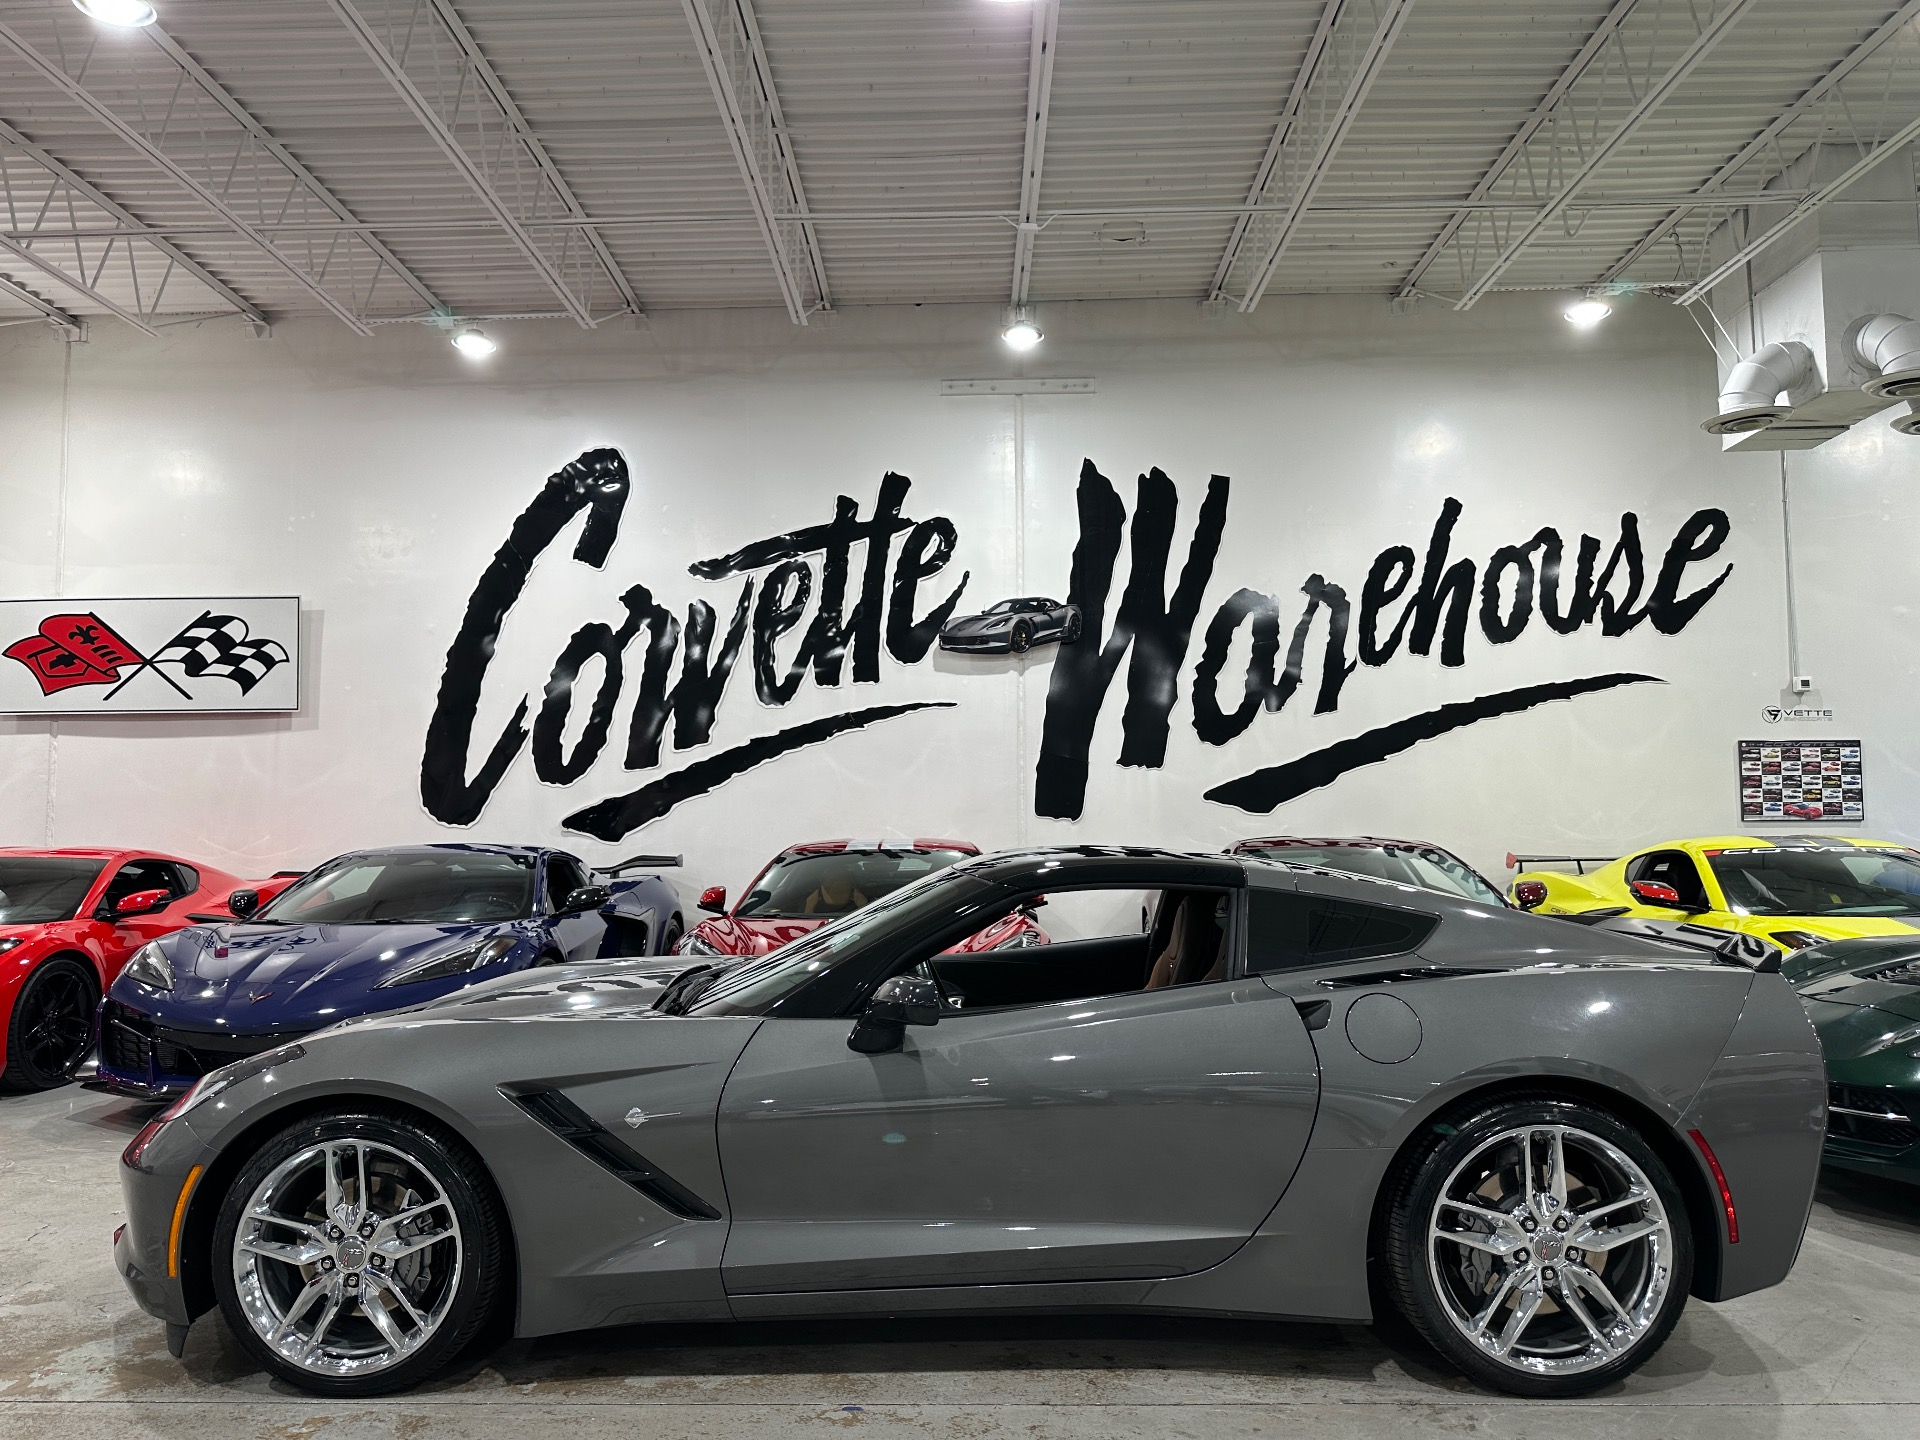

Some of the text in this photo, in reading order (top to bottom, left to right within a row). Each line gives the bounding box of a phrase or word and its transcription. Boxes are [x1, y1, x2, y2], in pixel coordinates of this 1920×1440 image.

[421, 447, 1733, 826] Corvette Warehouse
[1783, 709, 1833, 717] VETTE
[1722, 847, 1906, 855] CORVETTE
